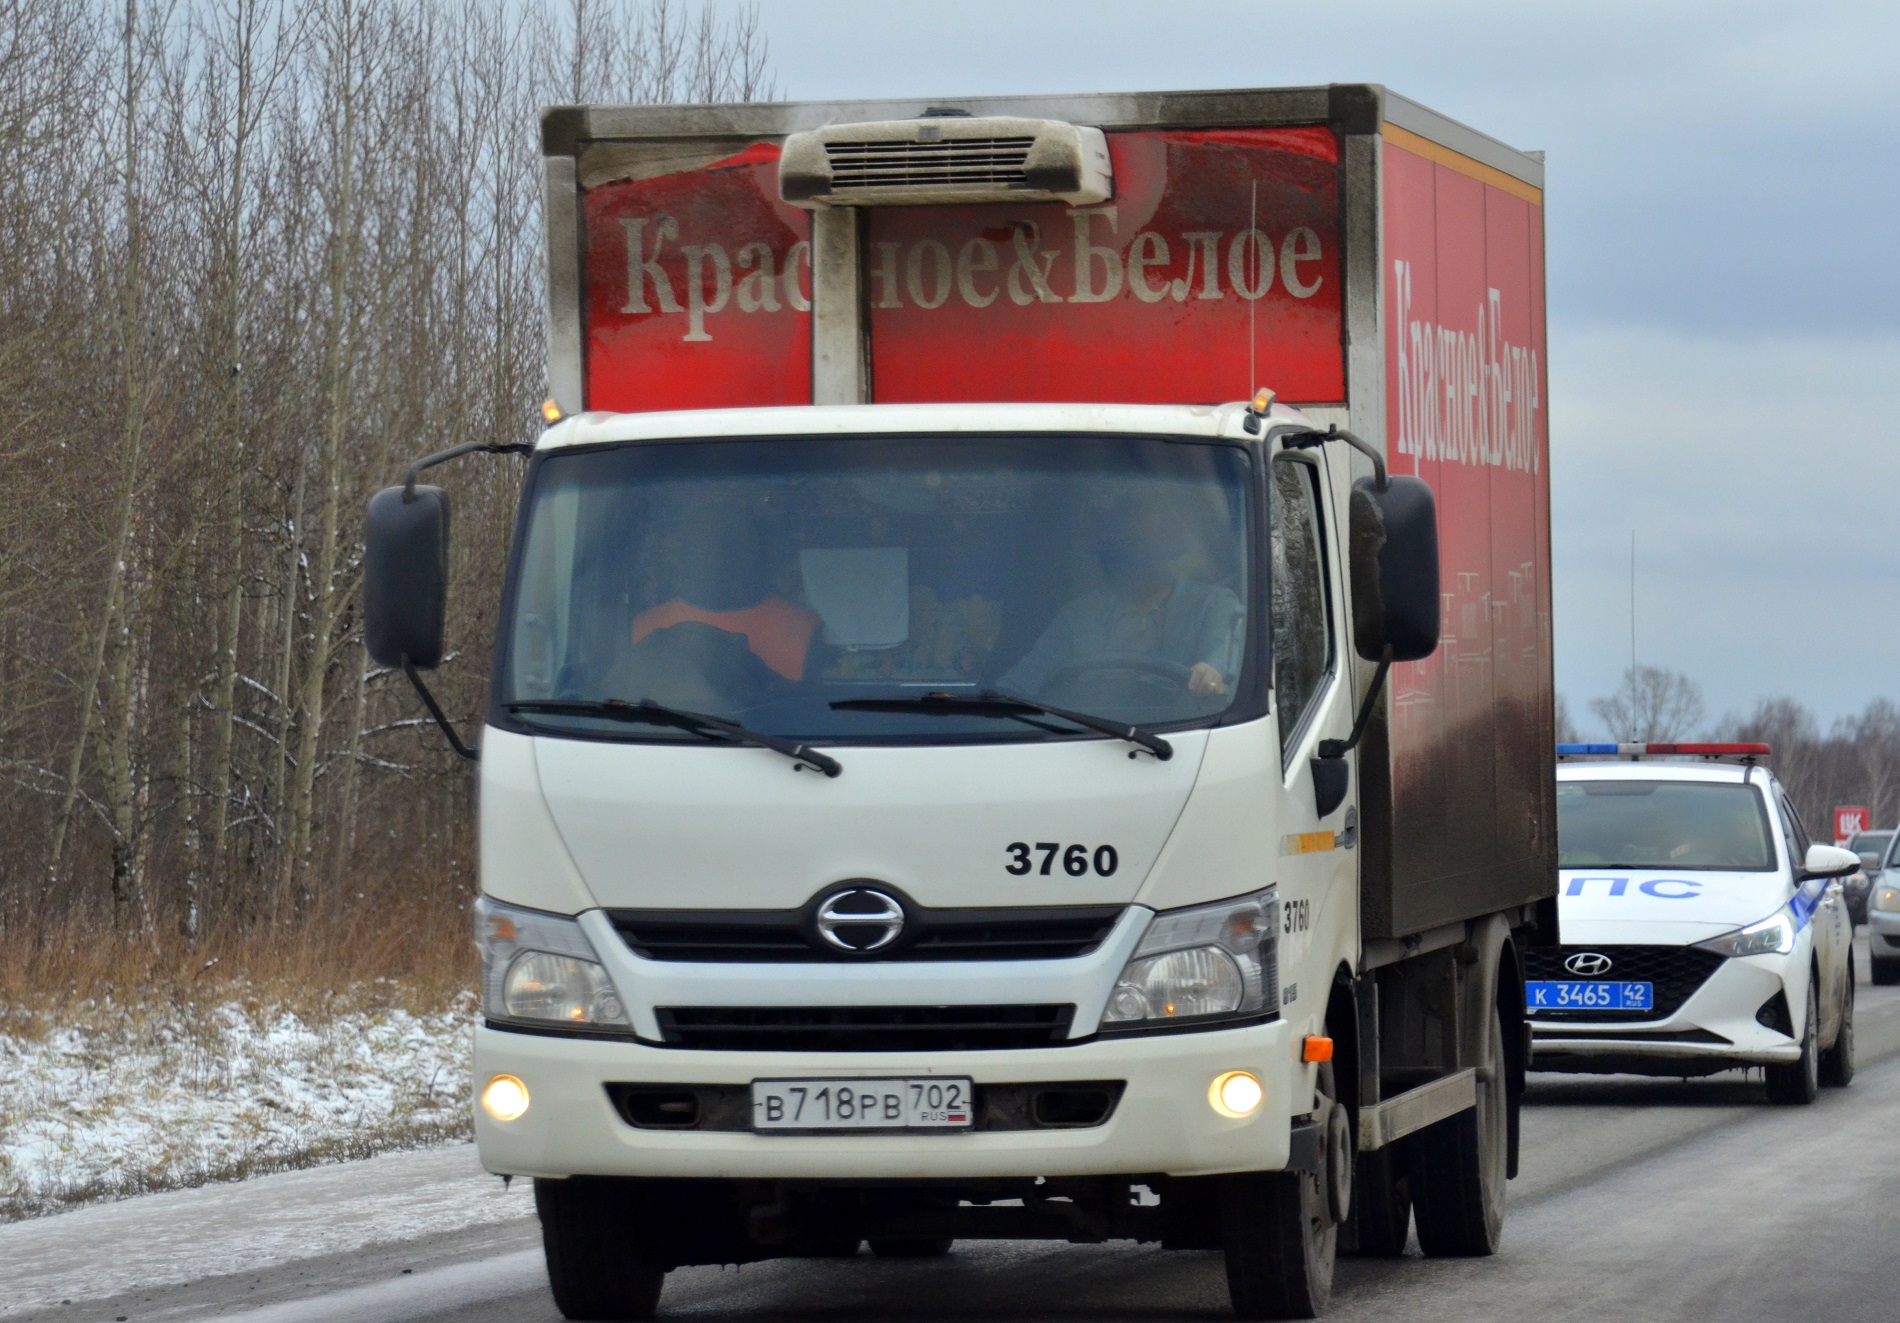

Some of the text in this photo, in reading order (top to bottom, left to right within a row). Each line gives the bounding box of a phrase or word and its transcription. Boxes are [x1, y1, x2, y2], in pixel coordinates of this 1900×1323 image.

[1394, 259, 1540, 478] Красное&Белое
[1005, 841, 1119, 878] 3760
[1565, 876, 1704, 899] ПС
[1284, 899, 1309, 934] 3760
[1535, 984, 1645, 1006] К 3465 42
[766, 1083, 963, 1122] В718РВ 702
[921, 1111, 948, 1122] RUS
